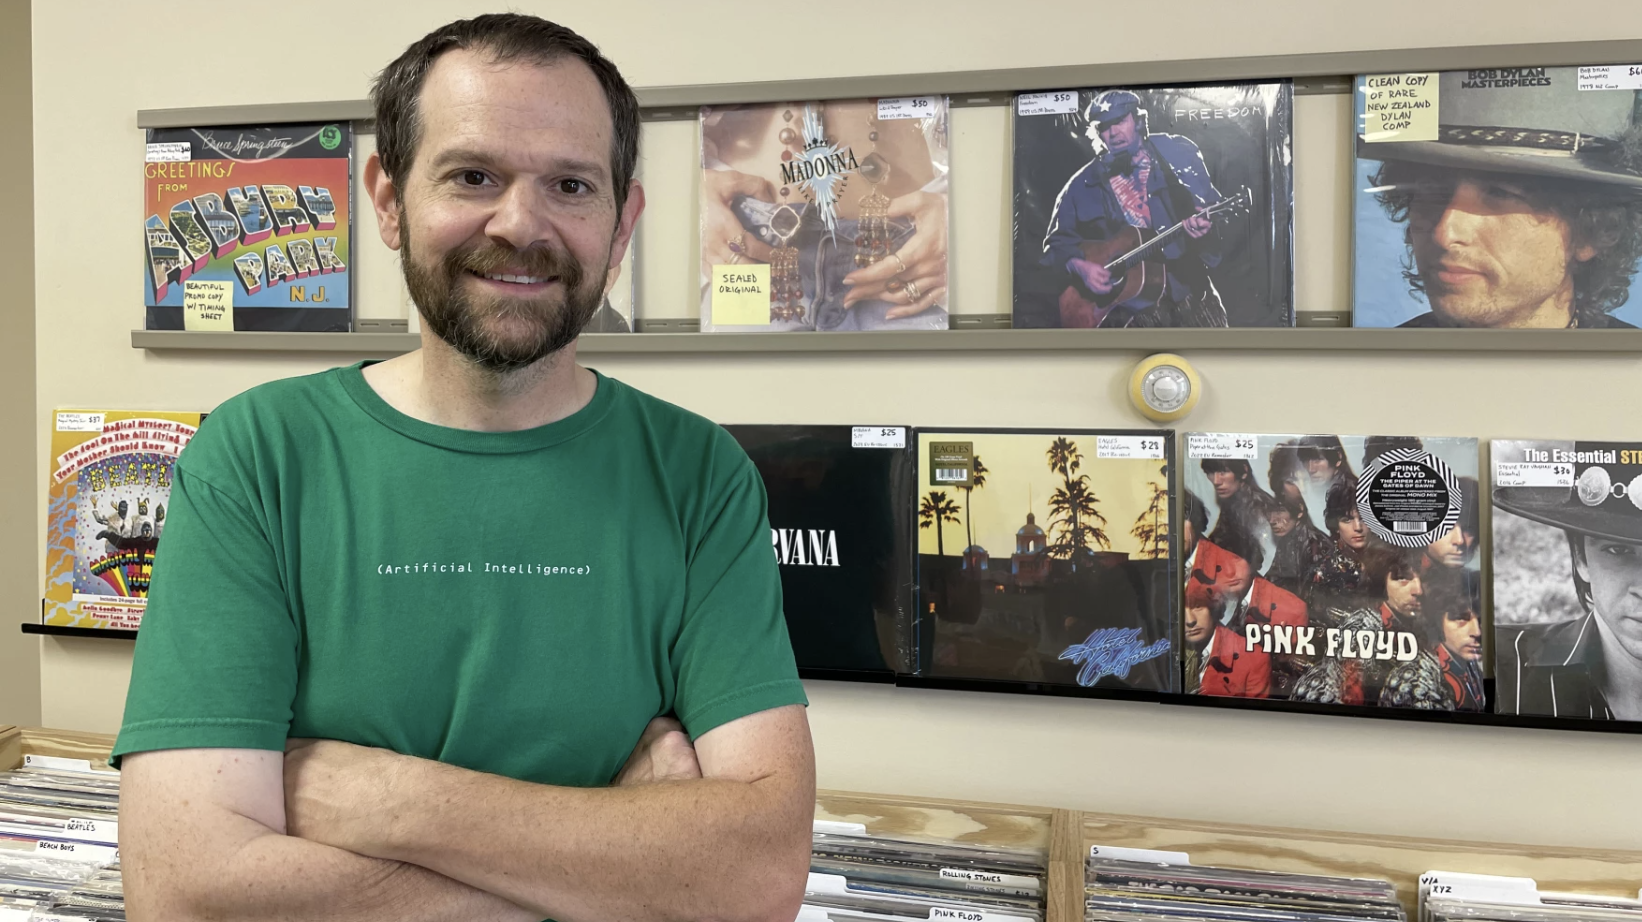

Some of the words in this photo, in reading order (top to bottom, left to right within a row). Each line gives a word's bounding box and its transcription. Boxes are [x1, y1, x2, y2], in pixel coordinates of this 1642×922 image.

[1468, 70, 1497, 80] BOB
[1501, 67, 1545, 79] DYLAN
[1368, 76, 1400, 87] CLEAN
[1405, 75, 1428, 86] COPY
[1462, 77, 1551, 89] MASTERPIECES
[1054, 92, 1071, 102] $50
[1370, 91, 1383, 99] OF
[1389, 89, 1418, 98] RARE
[912, 99, 928, 108] $50
[1368, 103, 1388, 111] NEW
[1391, 100, 1431, 109] ZEALAND
[1175, 106, 1262, 122] FREEDOM
[1381, 111, 1411, 121] DYLAN
[1383, 121, 1411, 131] COMP
[202, 130, 234, 150] Bruce
[231, 133, 293, 159] Springsteen
[144, 161, 236, 178] GREETINGS
[780, 147, 859, 185] MADONNA
[158, 183, 188, 202] FROM
[144, 185, 336, 305] ASBURY
[234, 236, 346, 296] PARK
[723, 273, 757, 283] SEALED
[290, 286, 330, 302] N.J.
[719, 285, 762, 294] ORIGINAL
[208, 293, 223, 302] COPY
[199, 303, 225, 312] TIMING
[138, 420, 172, 430] Mystery
[175, 423, 195, 437] Tour
[881, 428, 896, 436] $25
[101, 436, 113, 445] On
[114, 432, 130, 441] The
[1235, 439, 1253, 449] $25
[933, 445, 969, 453] EAGLES
[56, 467, 75, 480] Your
[142, 441, 165, 451] Know
[1524, 448, 1549, 462] The
[1552, 449, 1616, 464] Essential
[1554, 466, 1570, 475] $30
[90, 547, 140, 577] MAGICAL
[377, 562, 472, 575] (Artificial
[484, 562, 591, 576] Intelligence)
[1058, 627, 1142, 664] Hotel
[1326, 627, 1418, 661] FLOYD
[1076, 637, 1171, 687] California
[67, 823, 96, 831] BEATLES
[39, 842, 58, 850] BEACH
[942, 870, 971, 880] ROLLING
[974, 874, 1001, 882] STONES
[1421, 876, 1438, 885] V/A
[1432, 885, 1452, 894] XYZ
[935, 909, 956, 918] PINK
[958, 912, 983, 921] FLOYD
